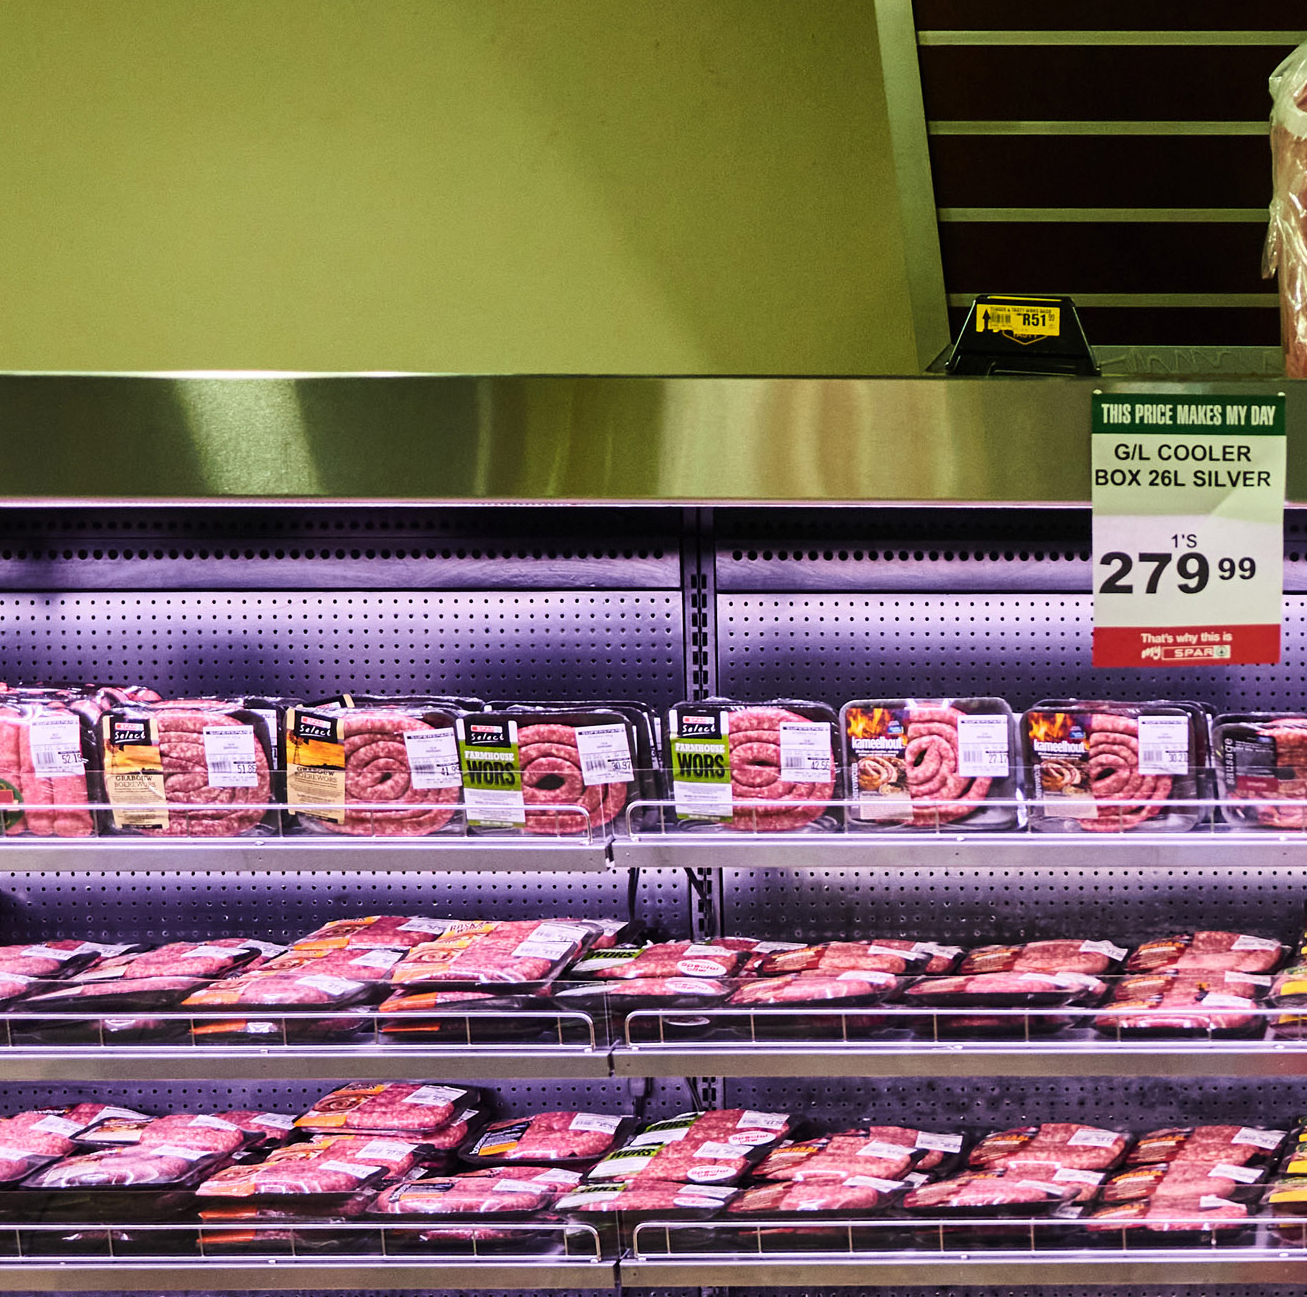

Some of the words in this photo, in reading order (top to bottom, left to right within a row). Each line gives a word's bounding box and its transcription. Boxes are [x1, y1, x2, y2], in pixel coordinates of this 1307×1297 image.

[1022, 313, 1046, 327] R51
[1101, 403, 1132, 424] THIS
[1135, 404, 1173, 425] PRICE
[1177, 405, 1222, 426] MAKES
[1226, 405, 1247, 426] MY
[1251, 405, 1276, 426] DAY
[1114, 443, 1150, 461] G/L
[1157, 444, 1252, 462] COOLER
[1095, 469, 1142, 487] BOX
[1149, 470, 1186, 487] 26L
[1193, 470, 1271, 488] SILVER
[1171, 534, 1198, 548] 1'S
[1099, 551, 1210, 595] 279
[1218, 557, 1257, 581] 99
[1141, 633, 1174, 643] That's
[1176, 633, 1198, 644] why
[1201, 632, 1220, 642] this
[1223, 632, 1233, 642] is
[1174, 646, 1214, 658] SPAR
[299, 724, 332, 738] Select
[682, 723, 716, 733] Select
[115, 730, 146, 741] Select
[471, 732, 505, 741] Select
[675, 743, 725, 753] FARMHOUSE
[464, 750, 515, 762] FARMHOUSE
[1224, 737, 1235, 785] sausage
[677, 752, 725, 779] WORS
[466, 761, 516, 786] WORS
[592, 949, 637, 960] WORS
[650, 1119, 692, 1131] WORS
[608, 1148, 657, 1160] WORS
